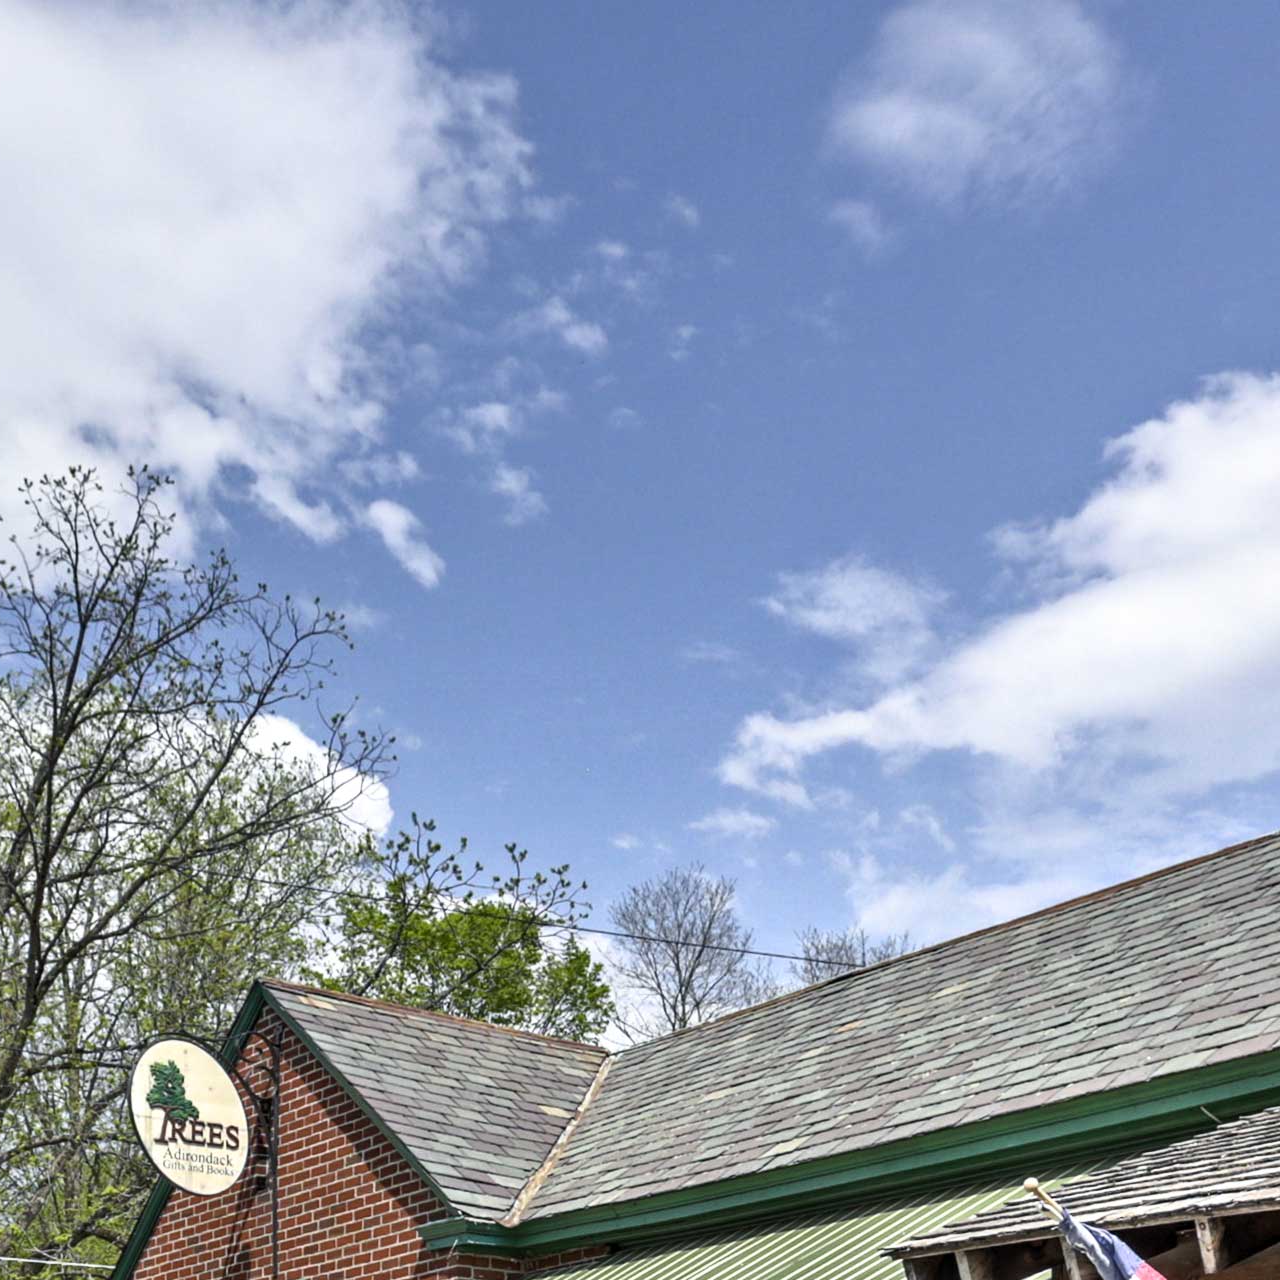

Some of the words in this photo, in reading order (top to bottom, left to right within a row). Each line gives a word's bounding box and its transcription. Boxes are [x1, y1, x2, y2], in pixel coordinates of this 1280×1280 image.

[153, 1111, 240, 1151] TREES
[163, 1148, 233, 1167] Adirondack
[163, 1161, 186, 1172] Gifts
[188, 1163, 204, 1173] and
[207, 1167, 235, 1178] Books
